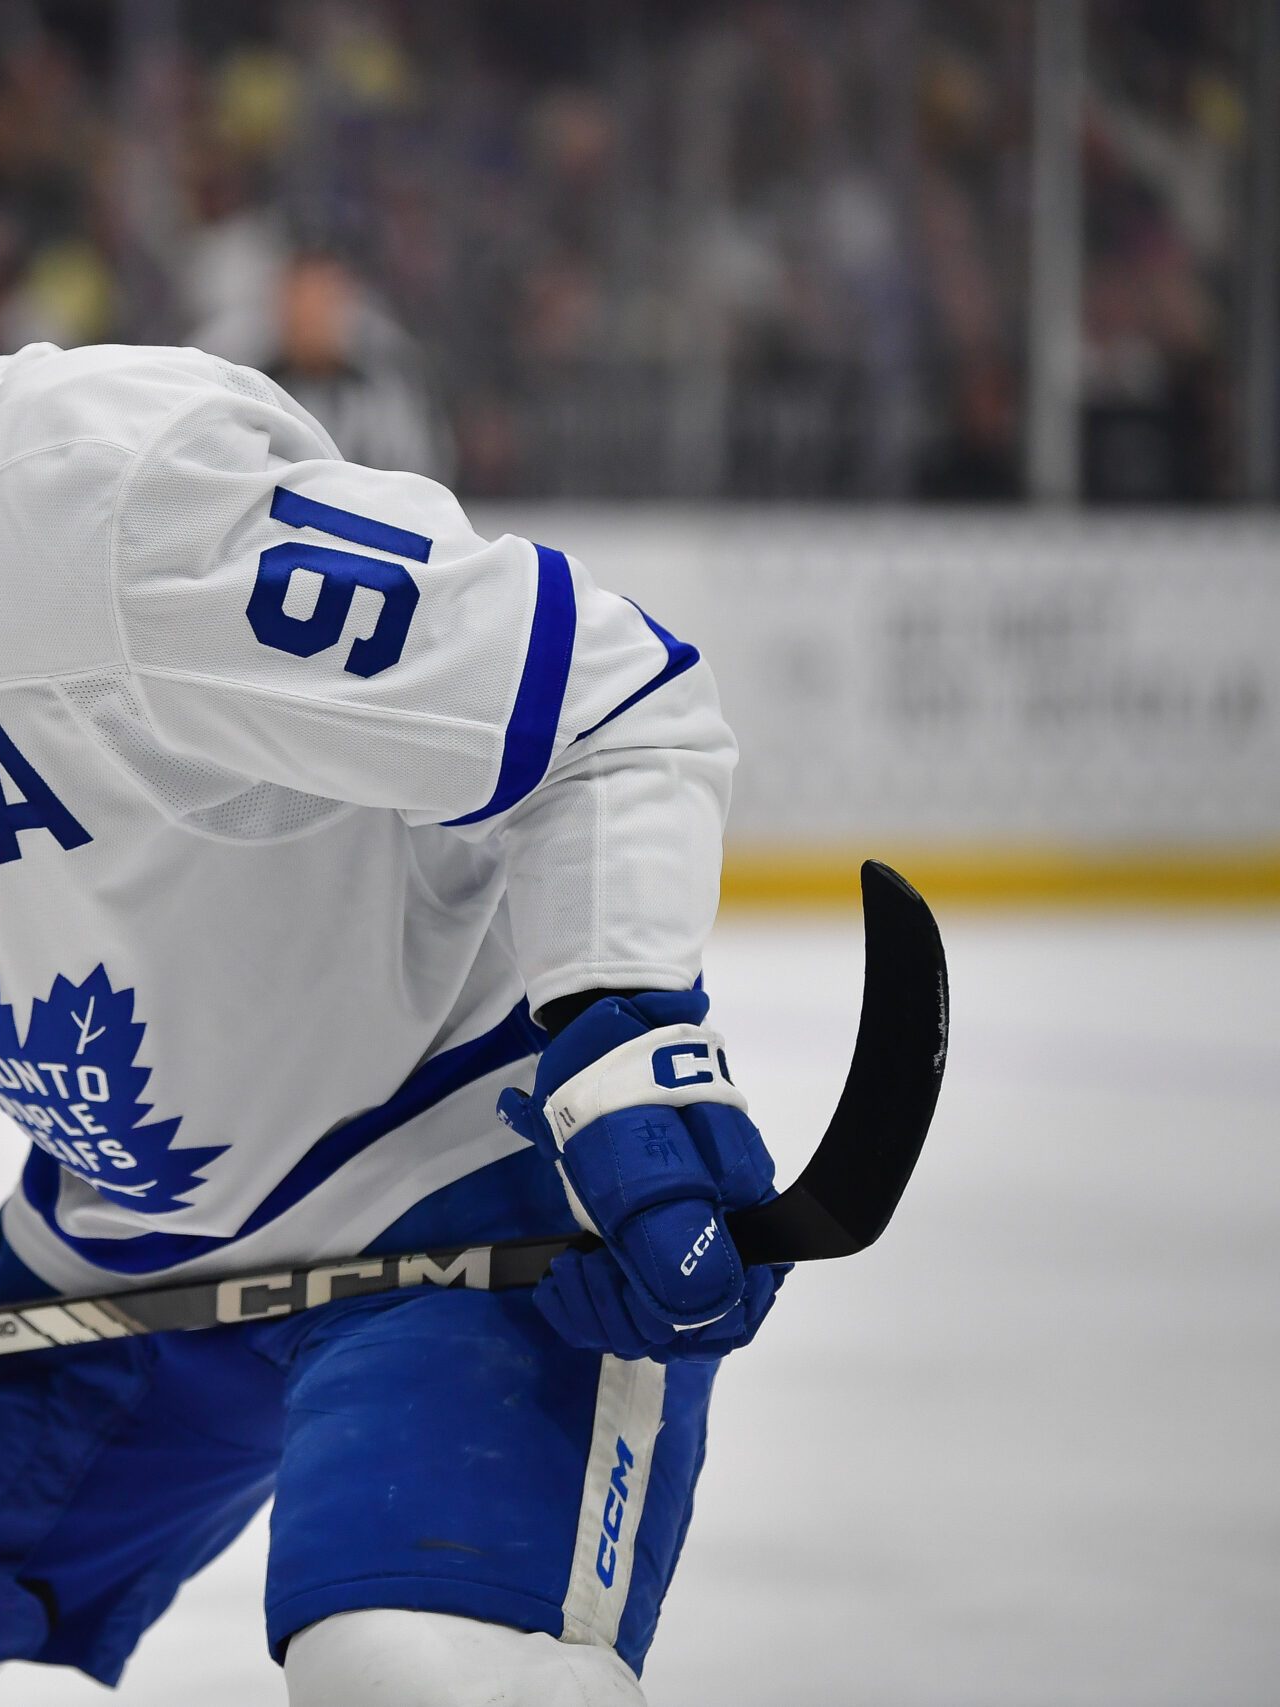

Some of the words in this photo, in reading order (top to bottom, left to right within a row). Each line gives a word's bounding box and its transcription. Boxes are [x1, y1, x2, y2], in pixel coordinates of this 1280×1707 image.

[245, 485, 433, 679] 91
[216, 1246, 492, 1324] CCM
[680, 1217, 720, 1276] CCM
[596, 1435, 634, 1589] CCM
